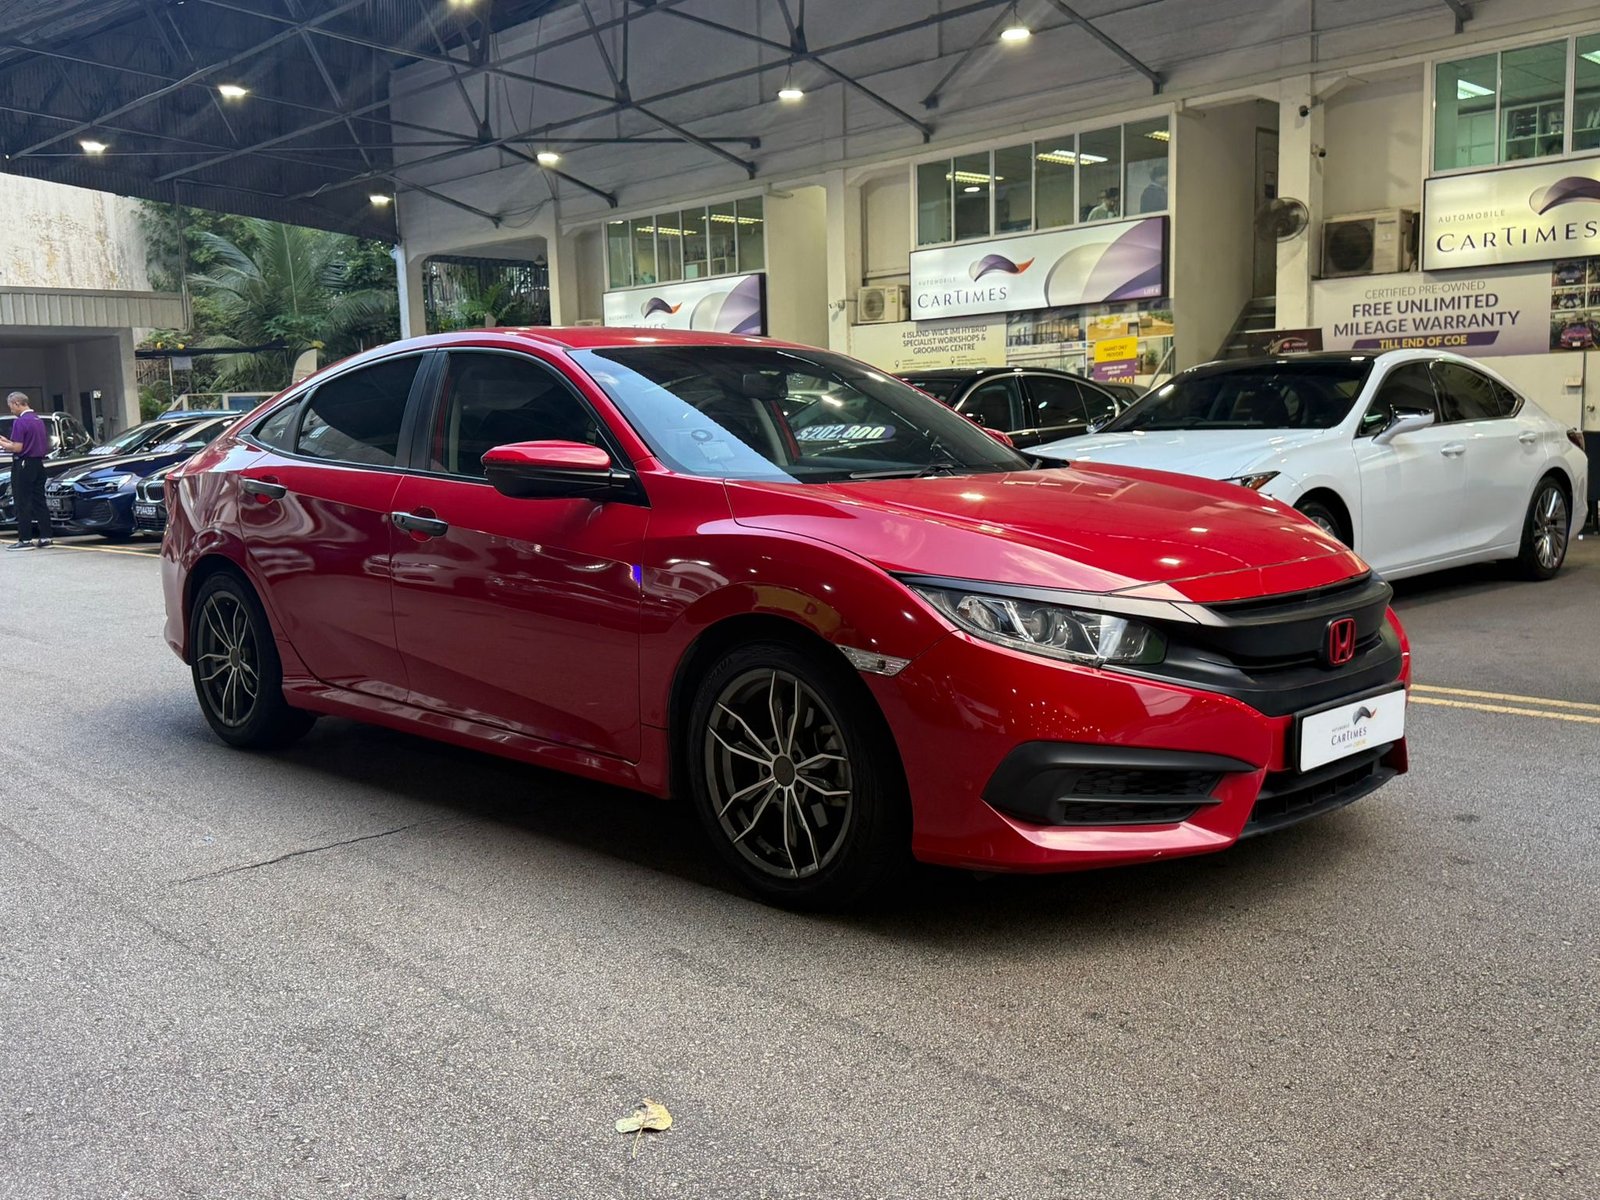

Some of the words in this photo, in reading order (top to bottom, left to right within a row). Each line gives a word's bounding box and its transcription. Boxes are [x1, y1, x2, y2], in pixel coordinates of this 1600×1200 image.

[1438, 209, 1506, 224] AUTOMOBILE
[1365, 286, 1416, 300] CERTIFIED
[1418, 280, 1486, 295] PRE-OWNED
[1352, 301, 1393, 318] FREE
[1397, 293, 1499, 315] UNLIMITED
[961, 325, 988, 334] HYBRID
[1333, 317, 1410, 337] MILEAGE
[1412, 310, 1521, 332] WARRANTY
[903, 337, 937, 347] SPECIALIST
[937, 334, 980, 345] WORKSHOPS
[981, 333, 986, 342] &
[1379, 338, 1400, 350] TILL
[1402, 336, 1425, 348] END
[1427, 335, 1442, 347] OF
[1444, 334, 1468, 346] COE
[913, 345, 949, 355] GROOMING
[950, 342, 976, 352] CENTRE
